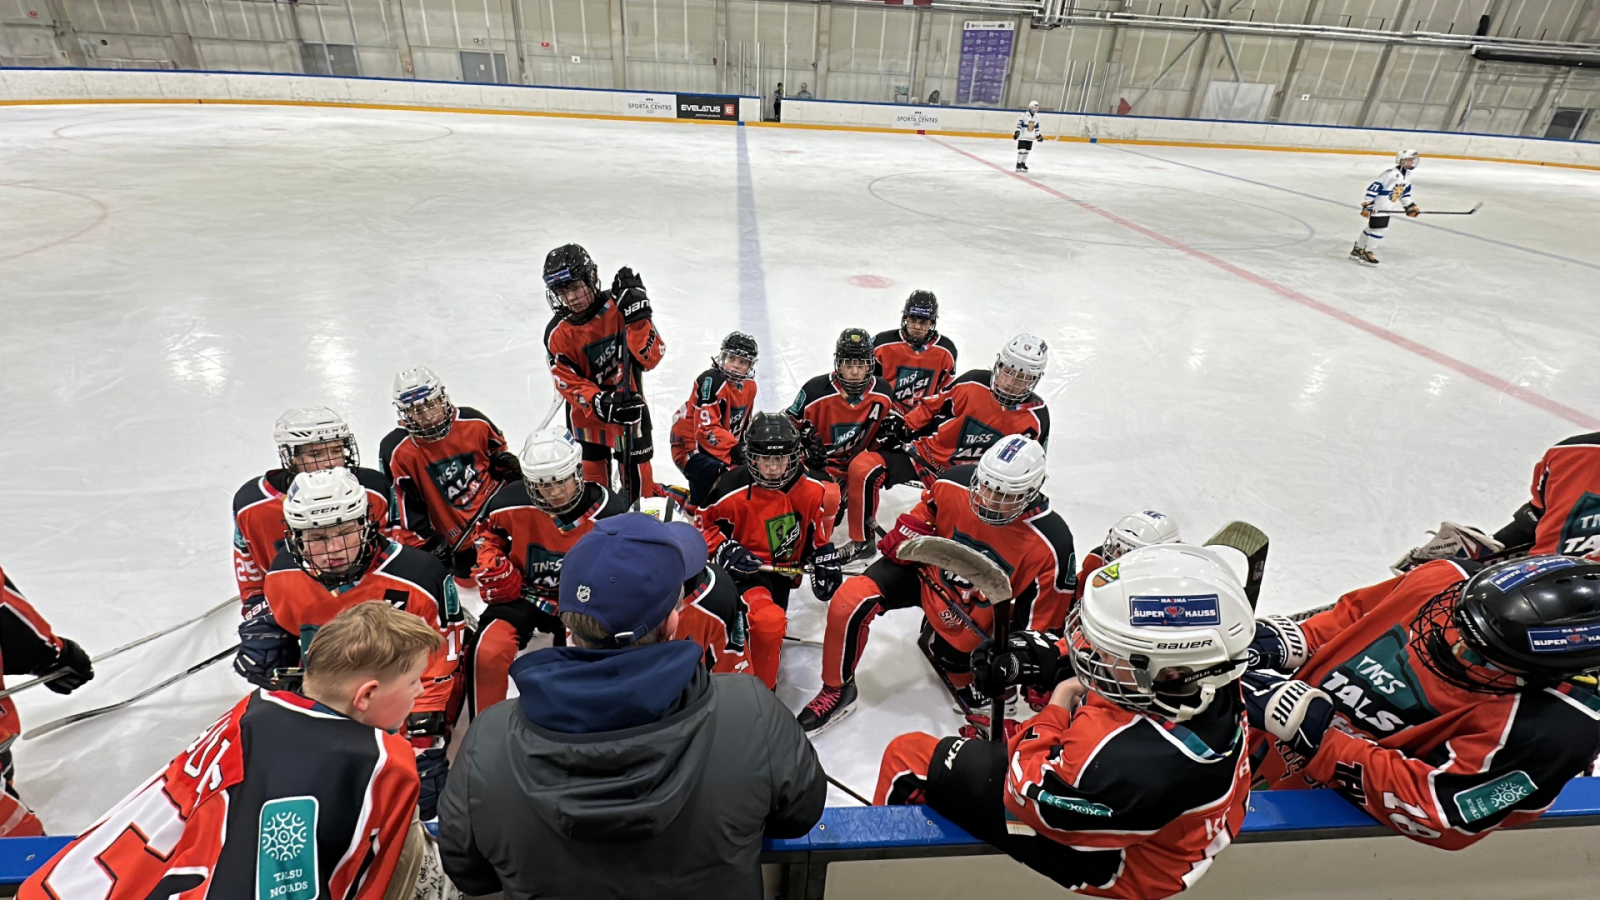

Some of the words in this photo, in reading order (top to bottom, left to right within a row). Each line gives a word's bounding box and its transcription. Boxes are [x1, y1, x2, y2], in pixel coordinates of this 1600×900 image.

[681, 104, 721, 113] EVELATUS
[868, 403, 880, 420] A
[310, 505, 341, 516] CCM
[236, 557, 263, 582] 25
[1133, 609, 1165, 618] SUPER
[1185, 609, 1216, 618] KAUSS
[1460, 610, 1488, 647] BAUER
[1157, 639, 1213, 650] BAUER
[1355, 655, 1406, 695] TNSS
[1322, 671, 1404, 731] TALS
[1383, 791, 1442, 840] 18
[1465, 798, 1481, 820] NOVAD
[273, 868, 303, 883] TALSU
[269, 880, 309, 899] NOADS
